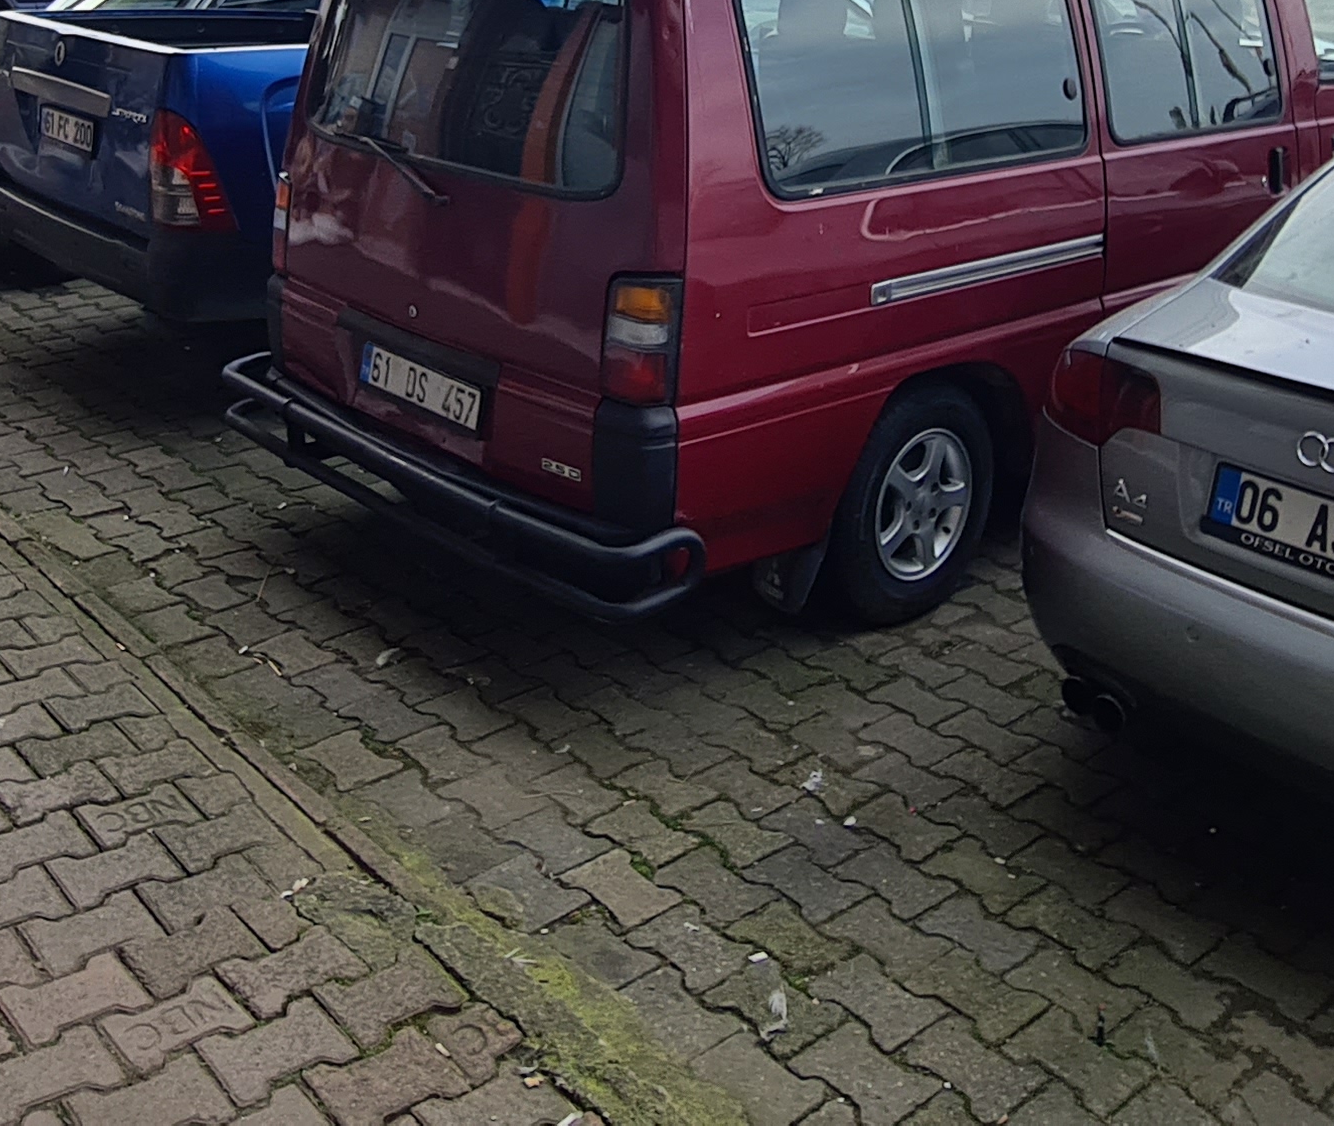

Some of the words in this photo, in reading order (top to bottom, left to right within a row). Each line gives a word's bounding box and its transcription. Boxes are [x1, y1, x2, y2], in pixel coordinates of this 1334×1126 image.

[371, 352, 391, 388] 61
[405, 366, 429, 404] DS
[441, 384, 477, 425] 457
[1113, 478, 1147, 509] A4
[1217, 498, 1233, 514] TR
[1234, 480, 1283, 533] 06
[1240, 532, 1295, 561] OFSEL
